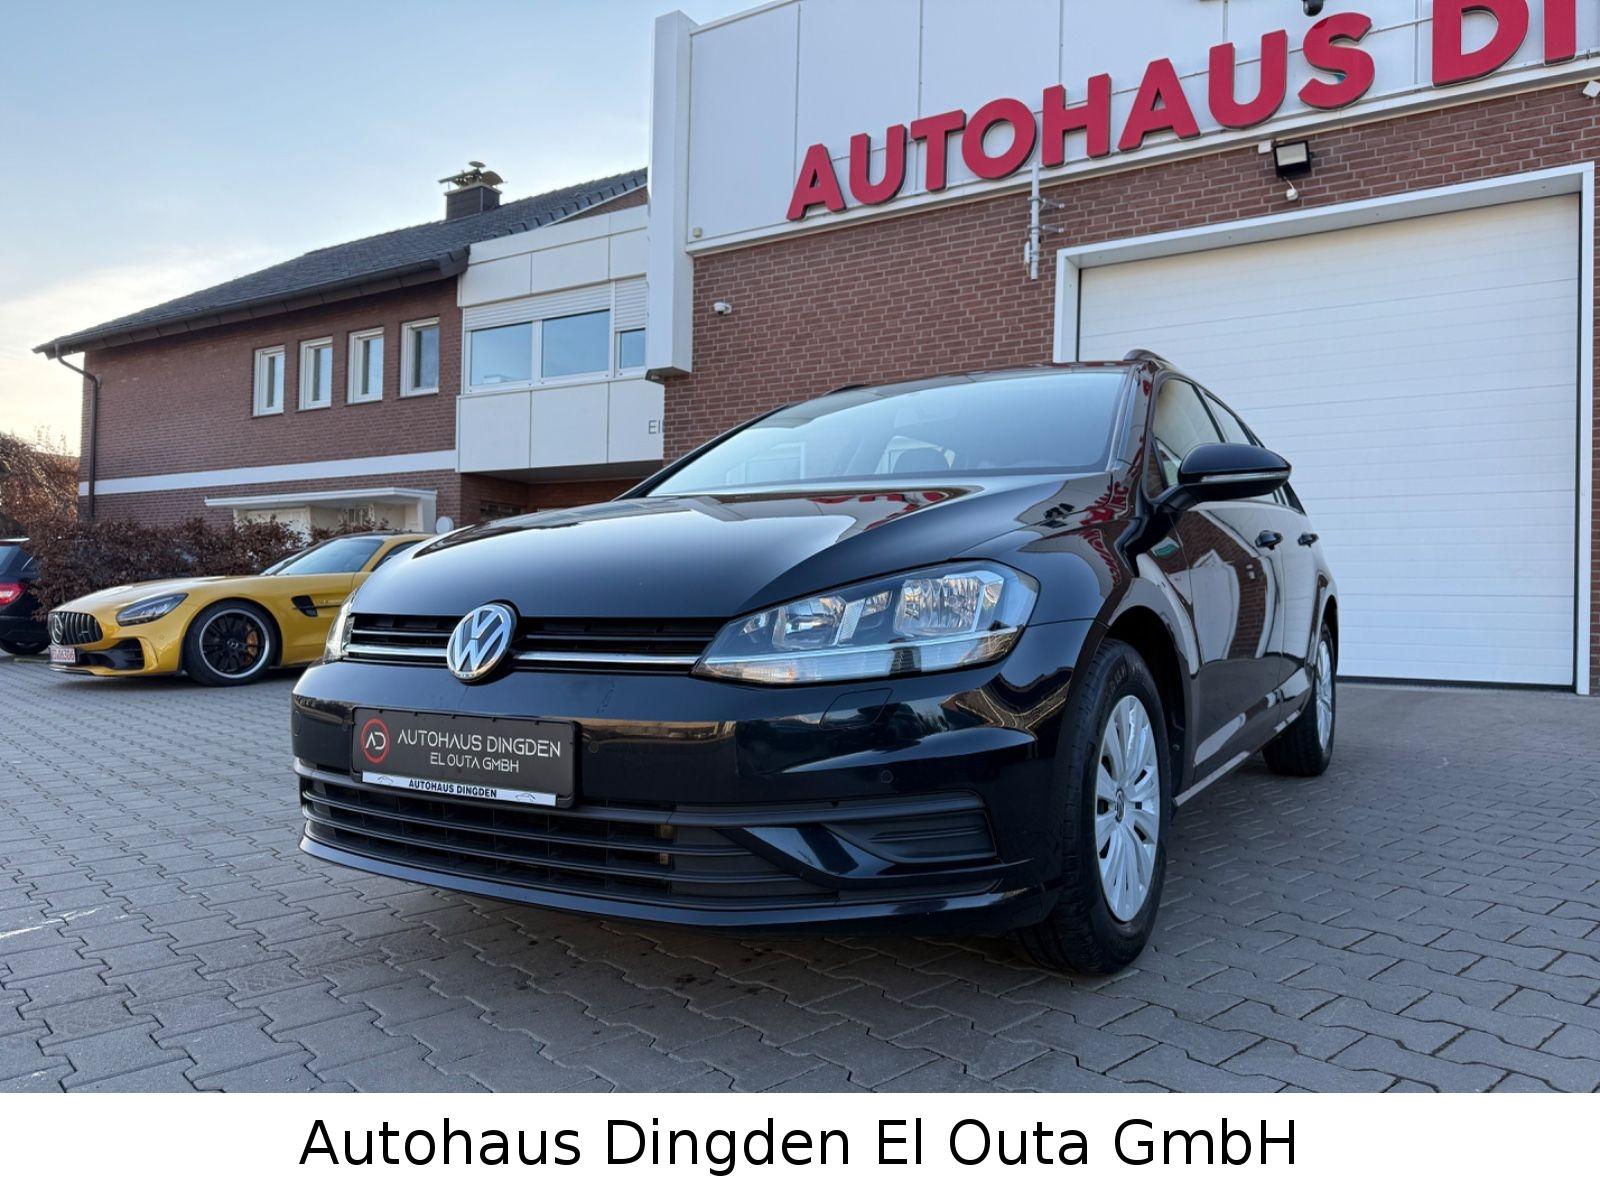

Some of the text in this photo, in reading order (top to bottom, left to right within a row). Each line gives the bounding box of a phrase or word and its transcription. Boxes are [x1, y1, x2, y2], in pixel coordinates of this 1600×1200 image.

[786, 12, 1375, 221] AUTOHAUS
[397, 729, 561, 758] AUTOHAUS DINGDEN
[430, 752, 519, 773] EL OUTA GMBH
[409, 779, 498, 798] AUTOHAUS DINGDEN
